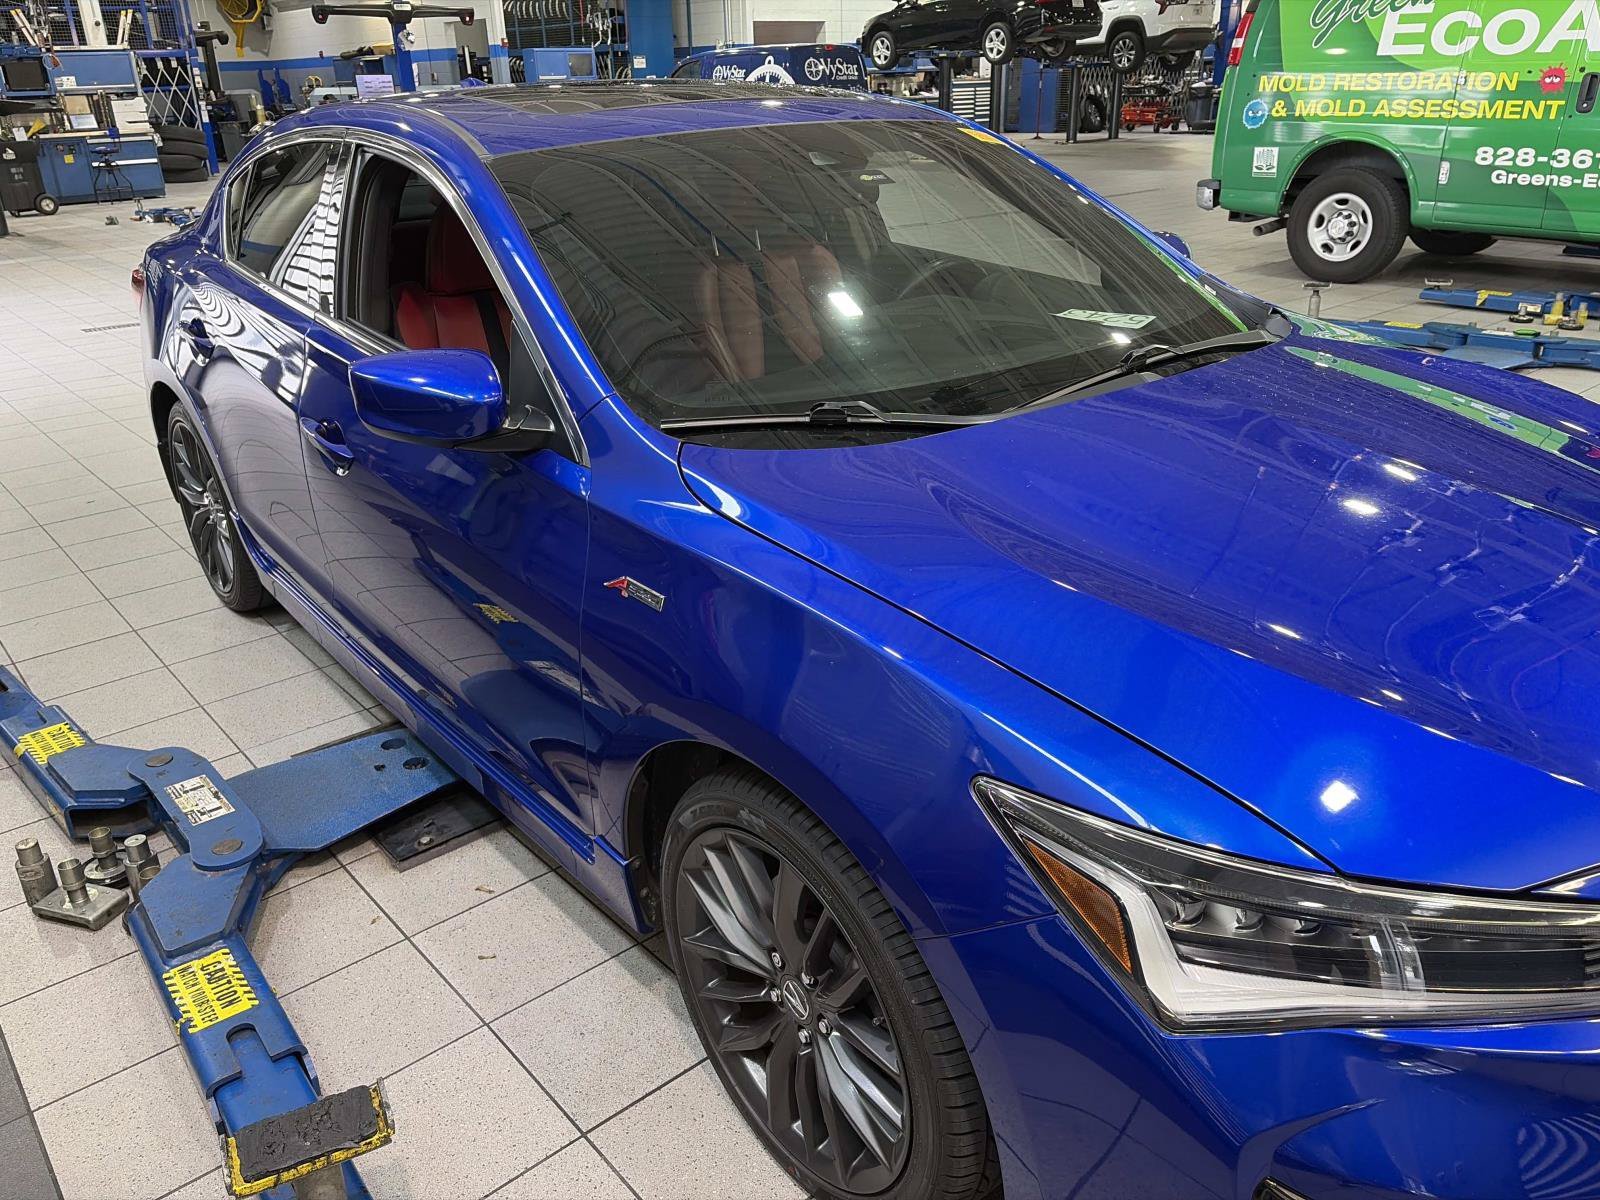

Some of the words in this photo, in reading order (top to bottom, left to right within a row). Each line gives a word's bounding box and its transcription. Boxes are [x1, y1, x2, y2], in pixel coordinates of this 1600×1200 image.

[820, 58, 858, 80] VyStar
[1258, 74, 1326, 92] MOLD
[1333, 72, 1518, 92] RESTORATION
[1271, 99, 1287, 117] &
[1294, 99, 1366, 117] MOLD
[1372, 99, 1565, 120] ASSESSMENT
[1491, 169, 1600, 188] Greens-E
[177, 964, 201, 990] WATCH
[200, 960, 242, 1010] CAUTION
[188, 986, 211, 1008] YOUR
[198, 1003, 219, 1024] STEP
